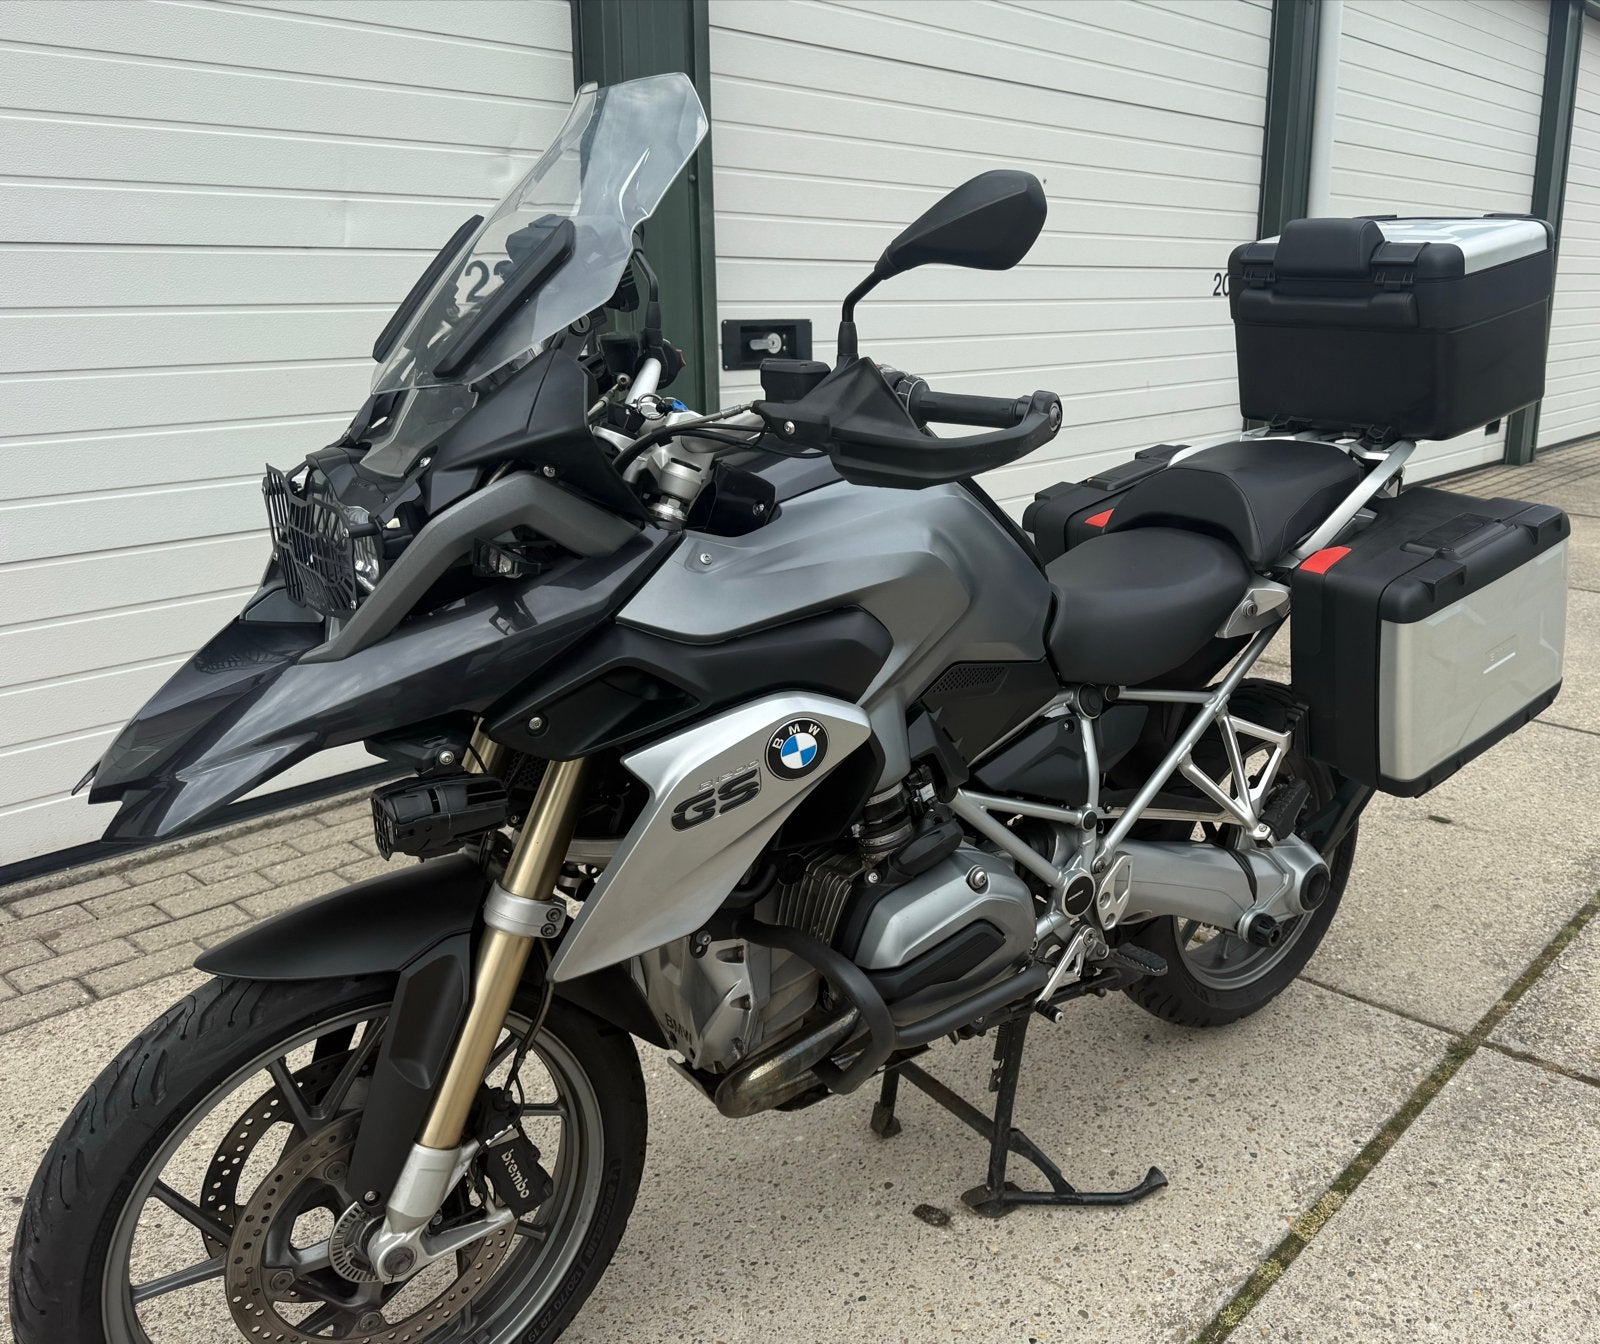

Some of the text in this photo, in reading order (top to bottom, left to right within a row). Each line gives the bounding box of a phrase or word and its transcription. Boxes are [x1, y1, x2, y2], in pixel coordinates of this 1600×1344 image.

[464, 259, 514, 303] 2
[1213, 272, 1230, 297] 20
[772, 723, 821, 750] BMW
[671, 767, 762, 832] GS
[664, 1012, 693, 1046] BMW
[500, 1148, 530, 1199] brembo
[584, 1183, 617, 1259] MICHELIN
[554, 1270, 582, 1310] 120/70
[527, 1328, 541, 1343] 19
